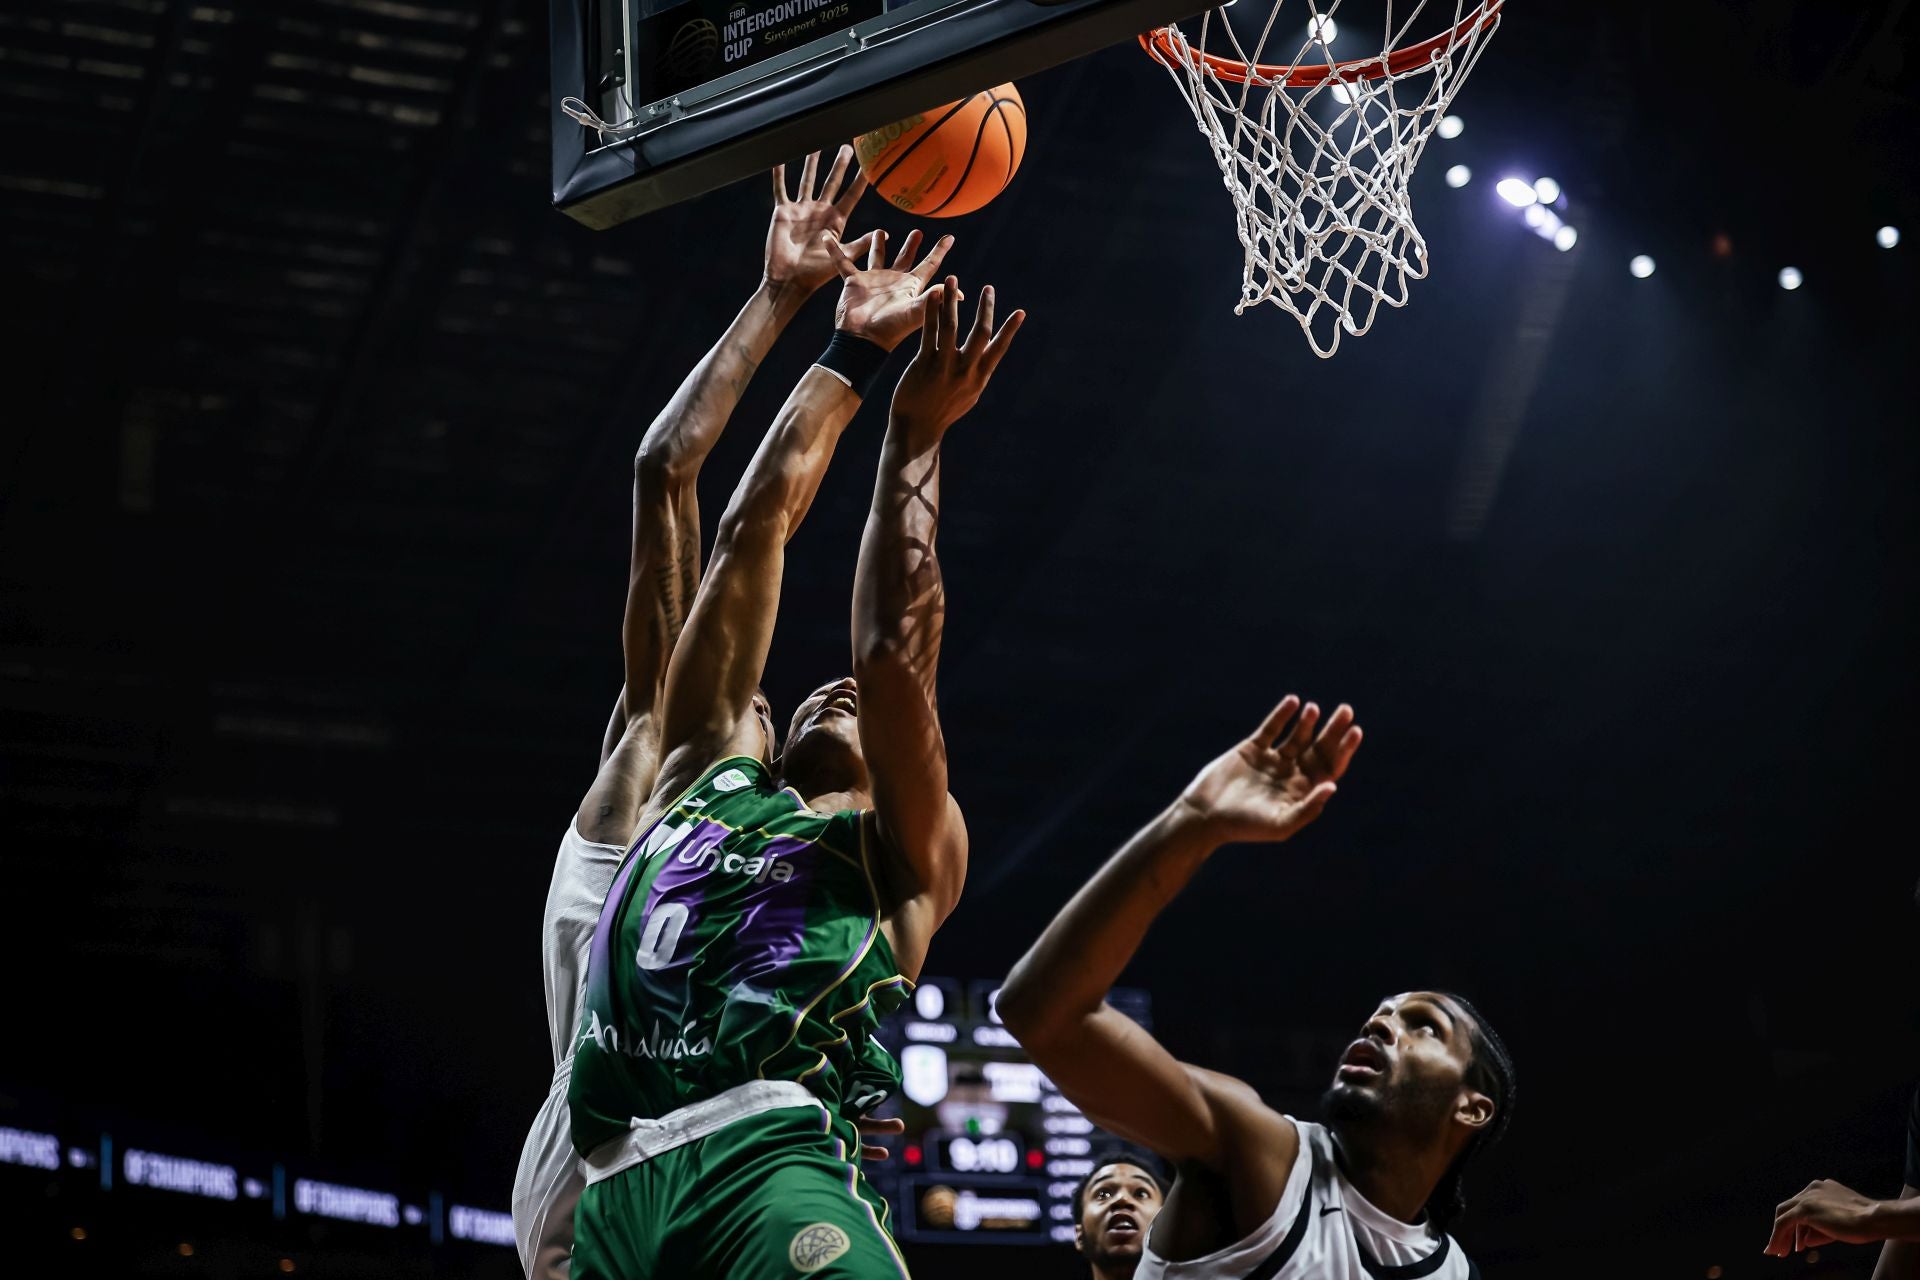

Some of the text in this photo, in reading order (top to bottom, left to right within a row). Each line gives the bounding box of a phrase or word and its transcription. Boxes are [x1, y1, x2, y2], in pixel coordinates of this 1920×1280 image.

[729, 8, 746, 20] FIBA
[764, 3, 849, 45] Singapore 2025
[724, 37, 753, 62] CUP
[636, 903, 689, 970] 0
